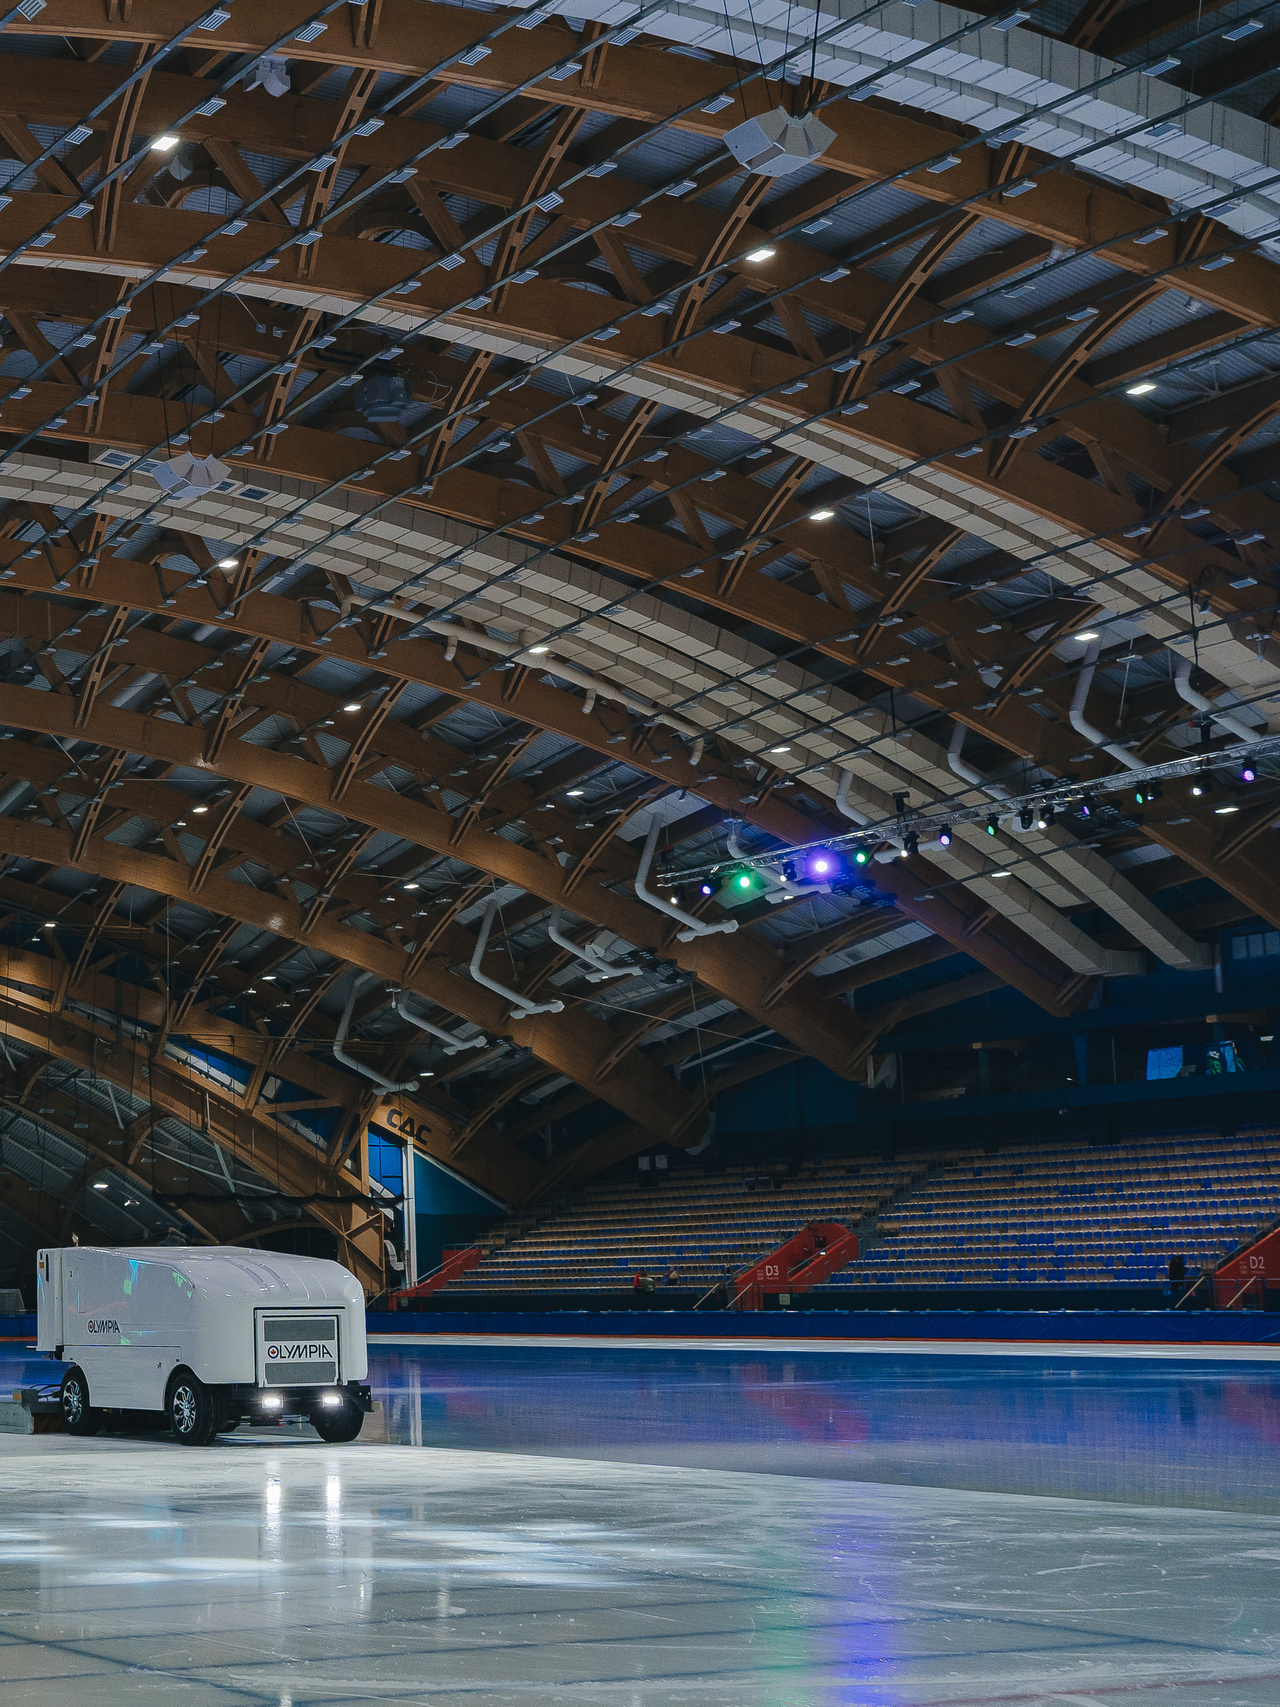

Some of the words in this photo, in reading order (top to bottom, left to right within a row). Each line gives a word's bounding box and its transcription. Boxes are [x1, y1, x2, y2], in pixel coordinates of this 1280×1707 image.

[1249, 1256, 1265, 1269] D2
[765, 1265, 779, 1276] D3
[87, 1319, 121, 1334] OLYMPIA
[267, 1344, 333, 1360] OLYMPIA
